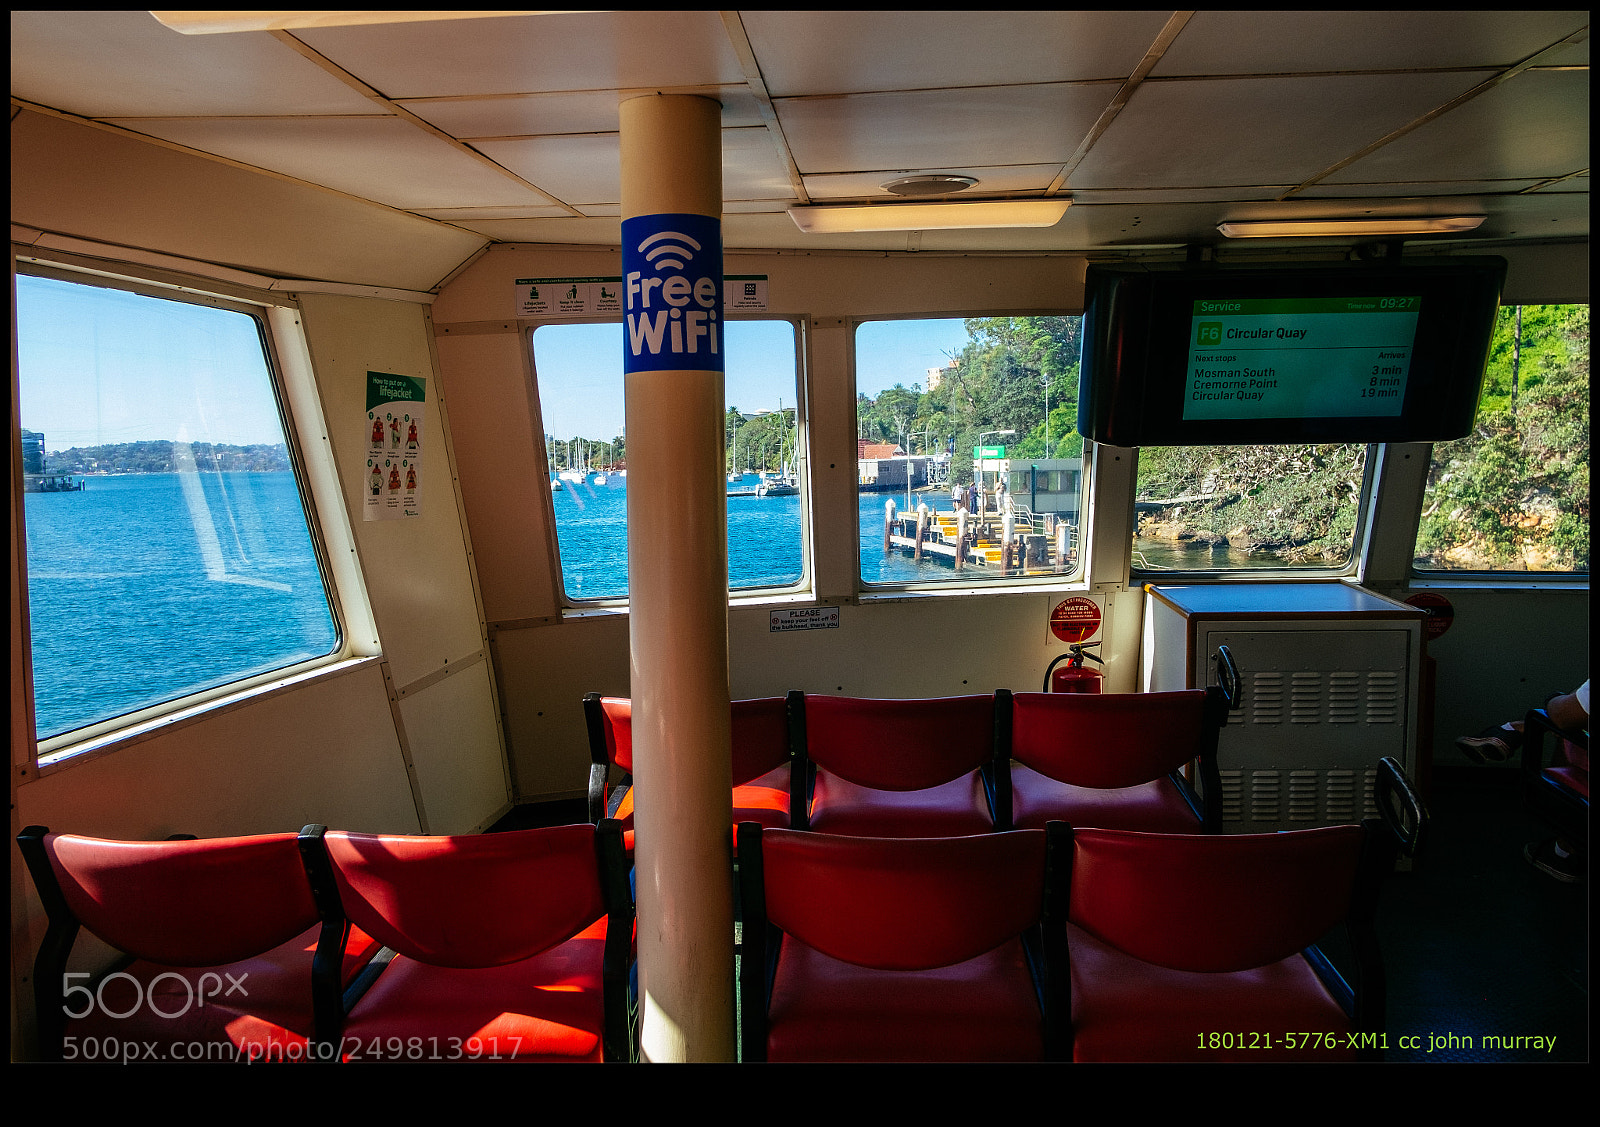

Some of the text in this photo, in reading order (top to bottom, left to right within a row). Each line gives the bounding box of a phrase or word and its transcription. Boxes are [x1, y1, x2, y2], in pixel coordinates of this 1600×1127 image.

[626, 271, 716, 310] Free
[1201, 301, 1241, 312] Service
[1380, 298, 1414, 309] 09:27
[627, 308, 718, 356] WiFi
[1200, 327, 1220, 340] F6
[1227, 328, 1307, 340] Circular Quay
[1215, 354, 1236, 363] stops
[1194, 368, 1275, 378] Mosman South
[1372, 366, 1402, 375] 3 min
[1193, 379, 1278, 390] Cremorne Point
[1370, 377, 1400, 386] 8 min
[380, 384, 412, 400] lifejacket
[1192, 390, 1264, 401] Circular Quay
[1360, 388, 1398, 398] 19 min
